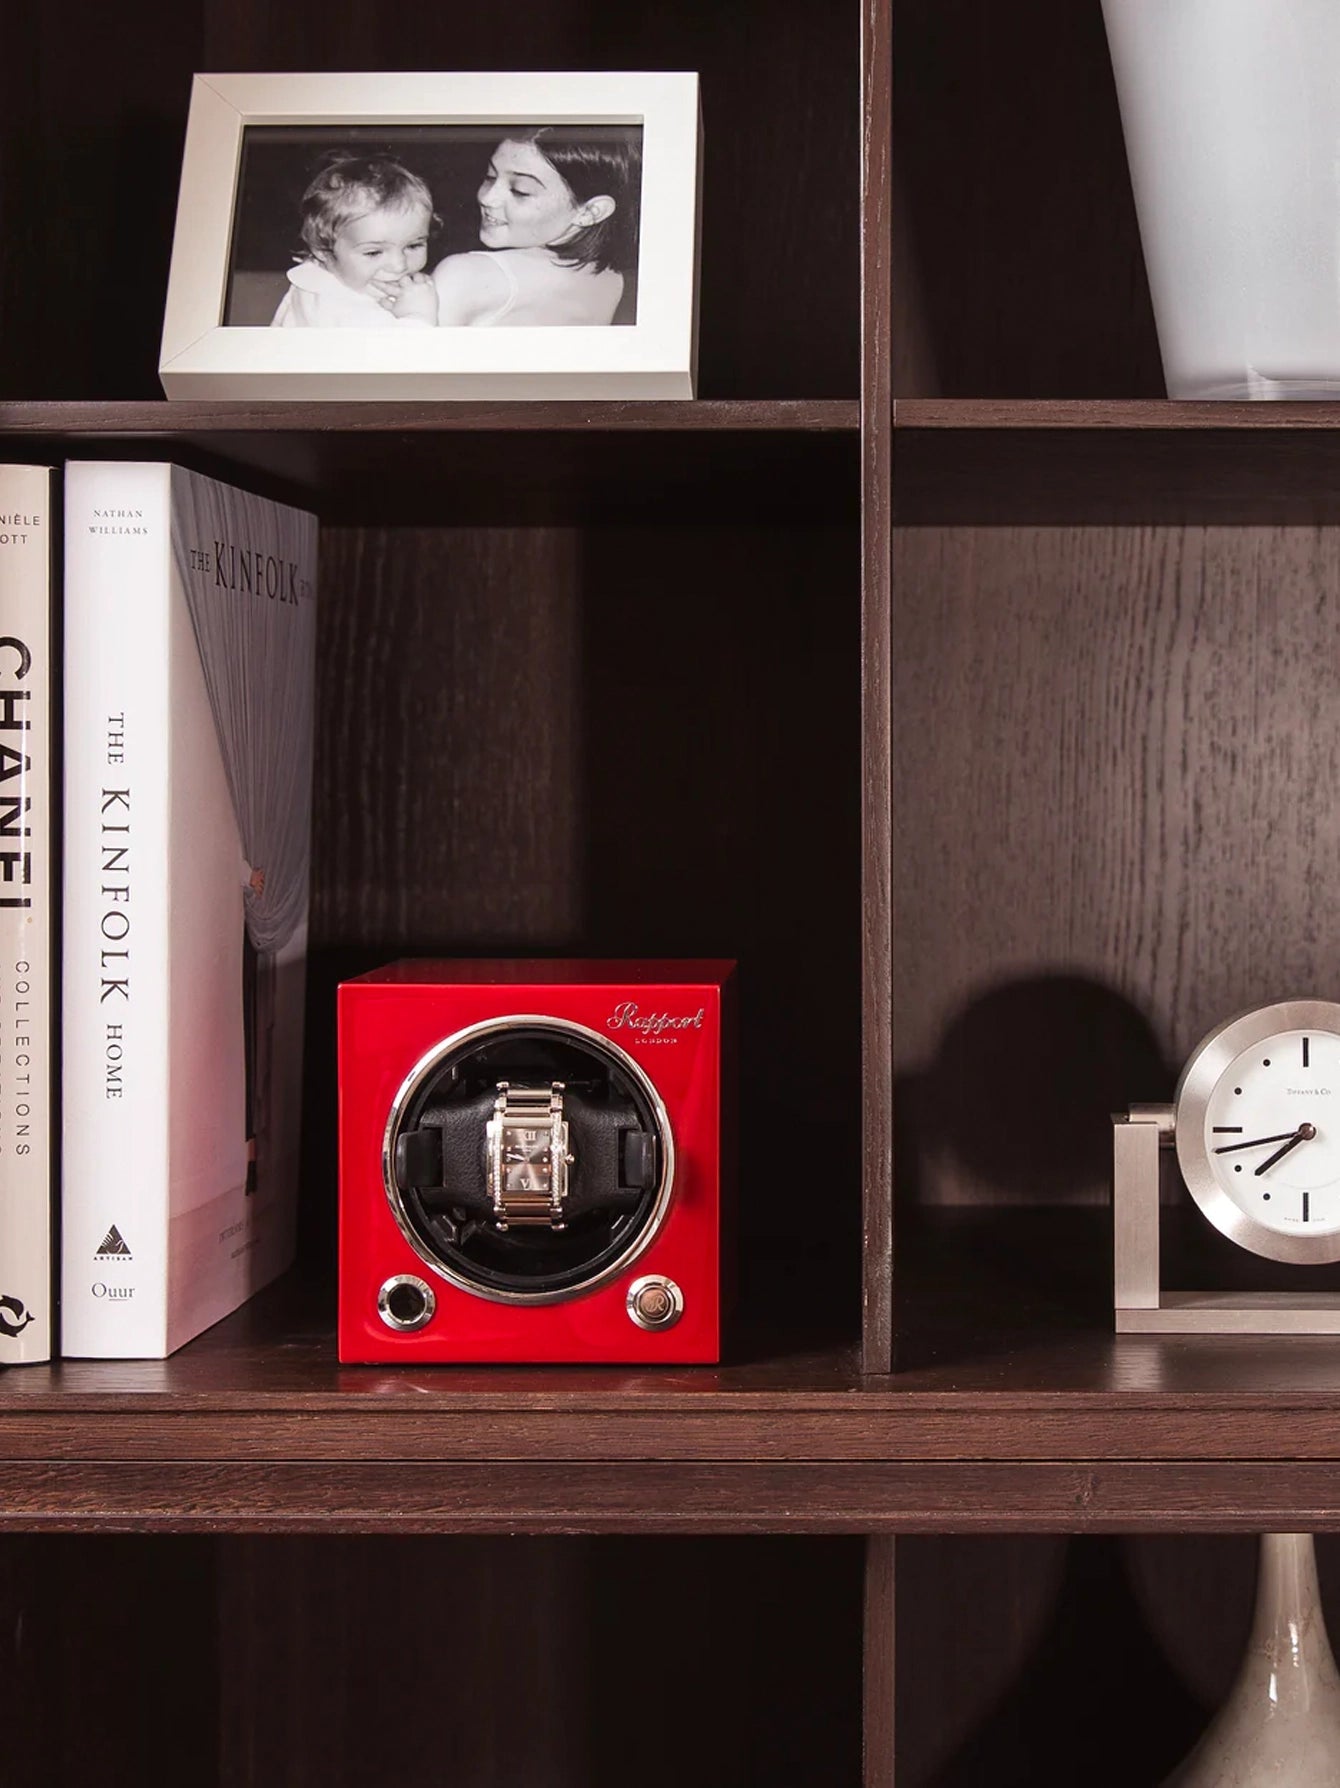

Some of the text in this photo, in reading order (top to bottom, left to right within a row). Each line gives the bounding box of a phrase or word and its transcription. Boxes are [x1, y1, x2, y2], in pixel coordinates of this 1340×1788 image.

[88, 526, 149, 535] WILLIAMS
[93, 510, 143, 518] NATHAN
[190, 549, 211, 573] THE
[214, 540, 299, 607] KINFOLK
[101, 712, 130, 1099] THE KINFOLK HOME
[606, 1002, 705, 1035] Rapport
[15, 960, 30, 1155] COLLECTIONS
[91, 1282, 135, 1299] Ouur
